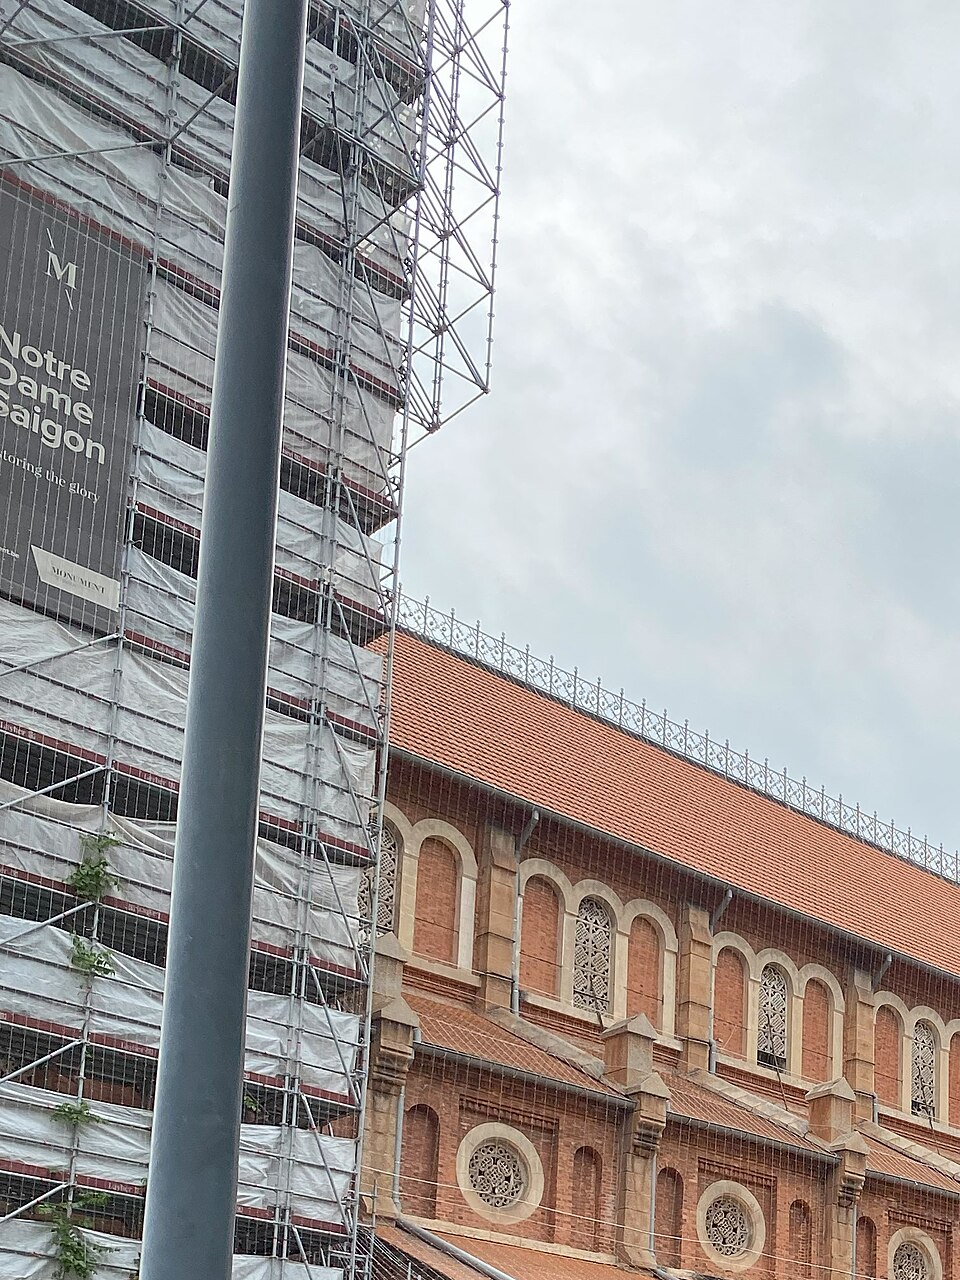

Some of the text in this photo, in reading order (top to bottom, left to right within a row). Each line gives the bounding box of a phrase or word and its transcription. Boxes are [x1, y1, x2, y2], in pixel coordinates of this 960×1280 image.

[42, 249, 79, 290] M
[0, 324, 91, 391] Notre
[0, 357, 94, 424] Dame
[0, 389, 106, 465] Saigon
[46, 468, 66, 488] the
[69, 481, 100, 504] glory
[51, 566, 105, 593] MONUMENT
